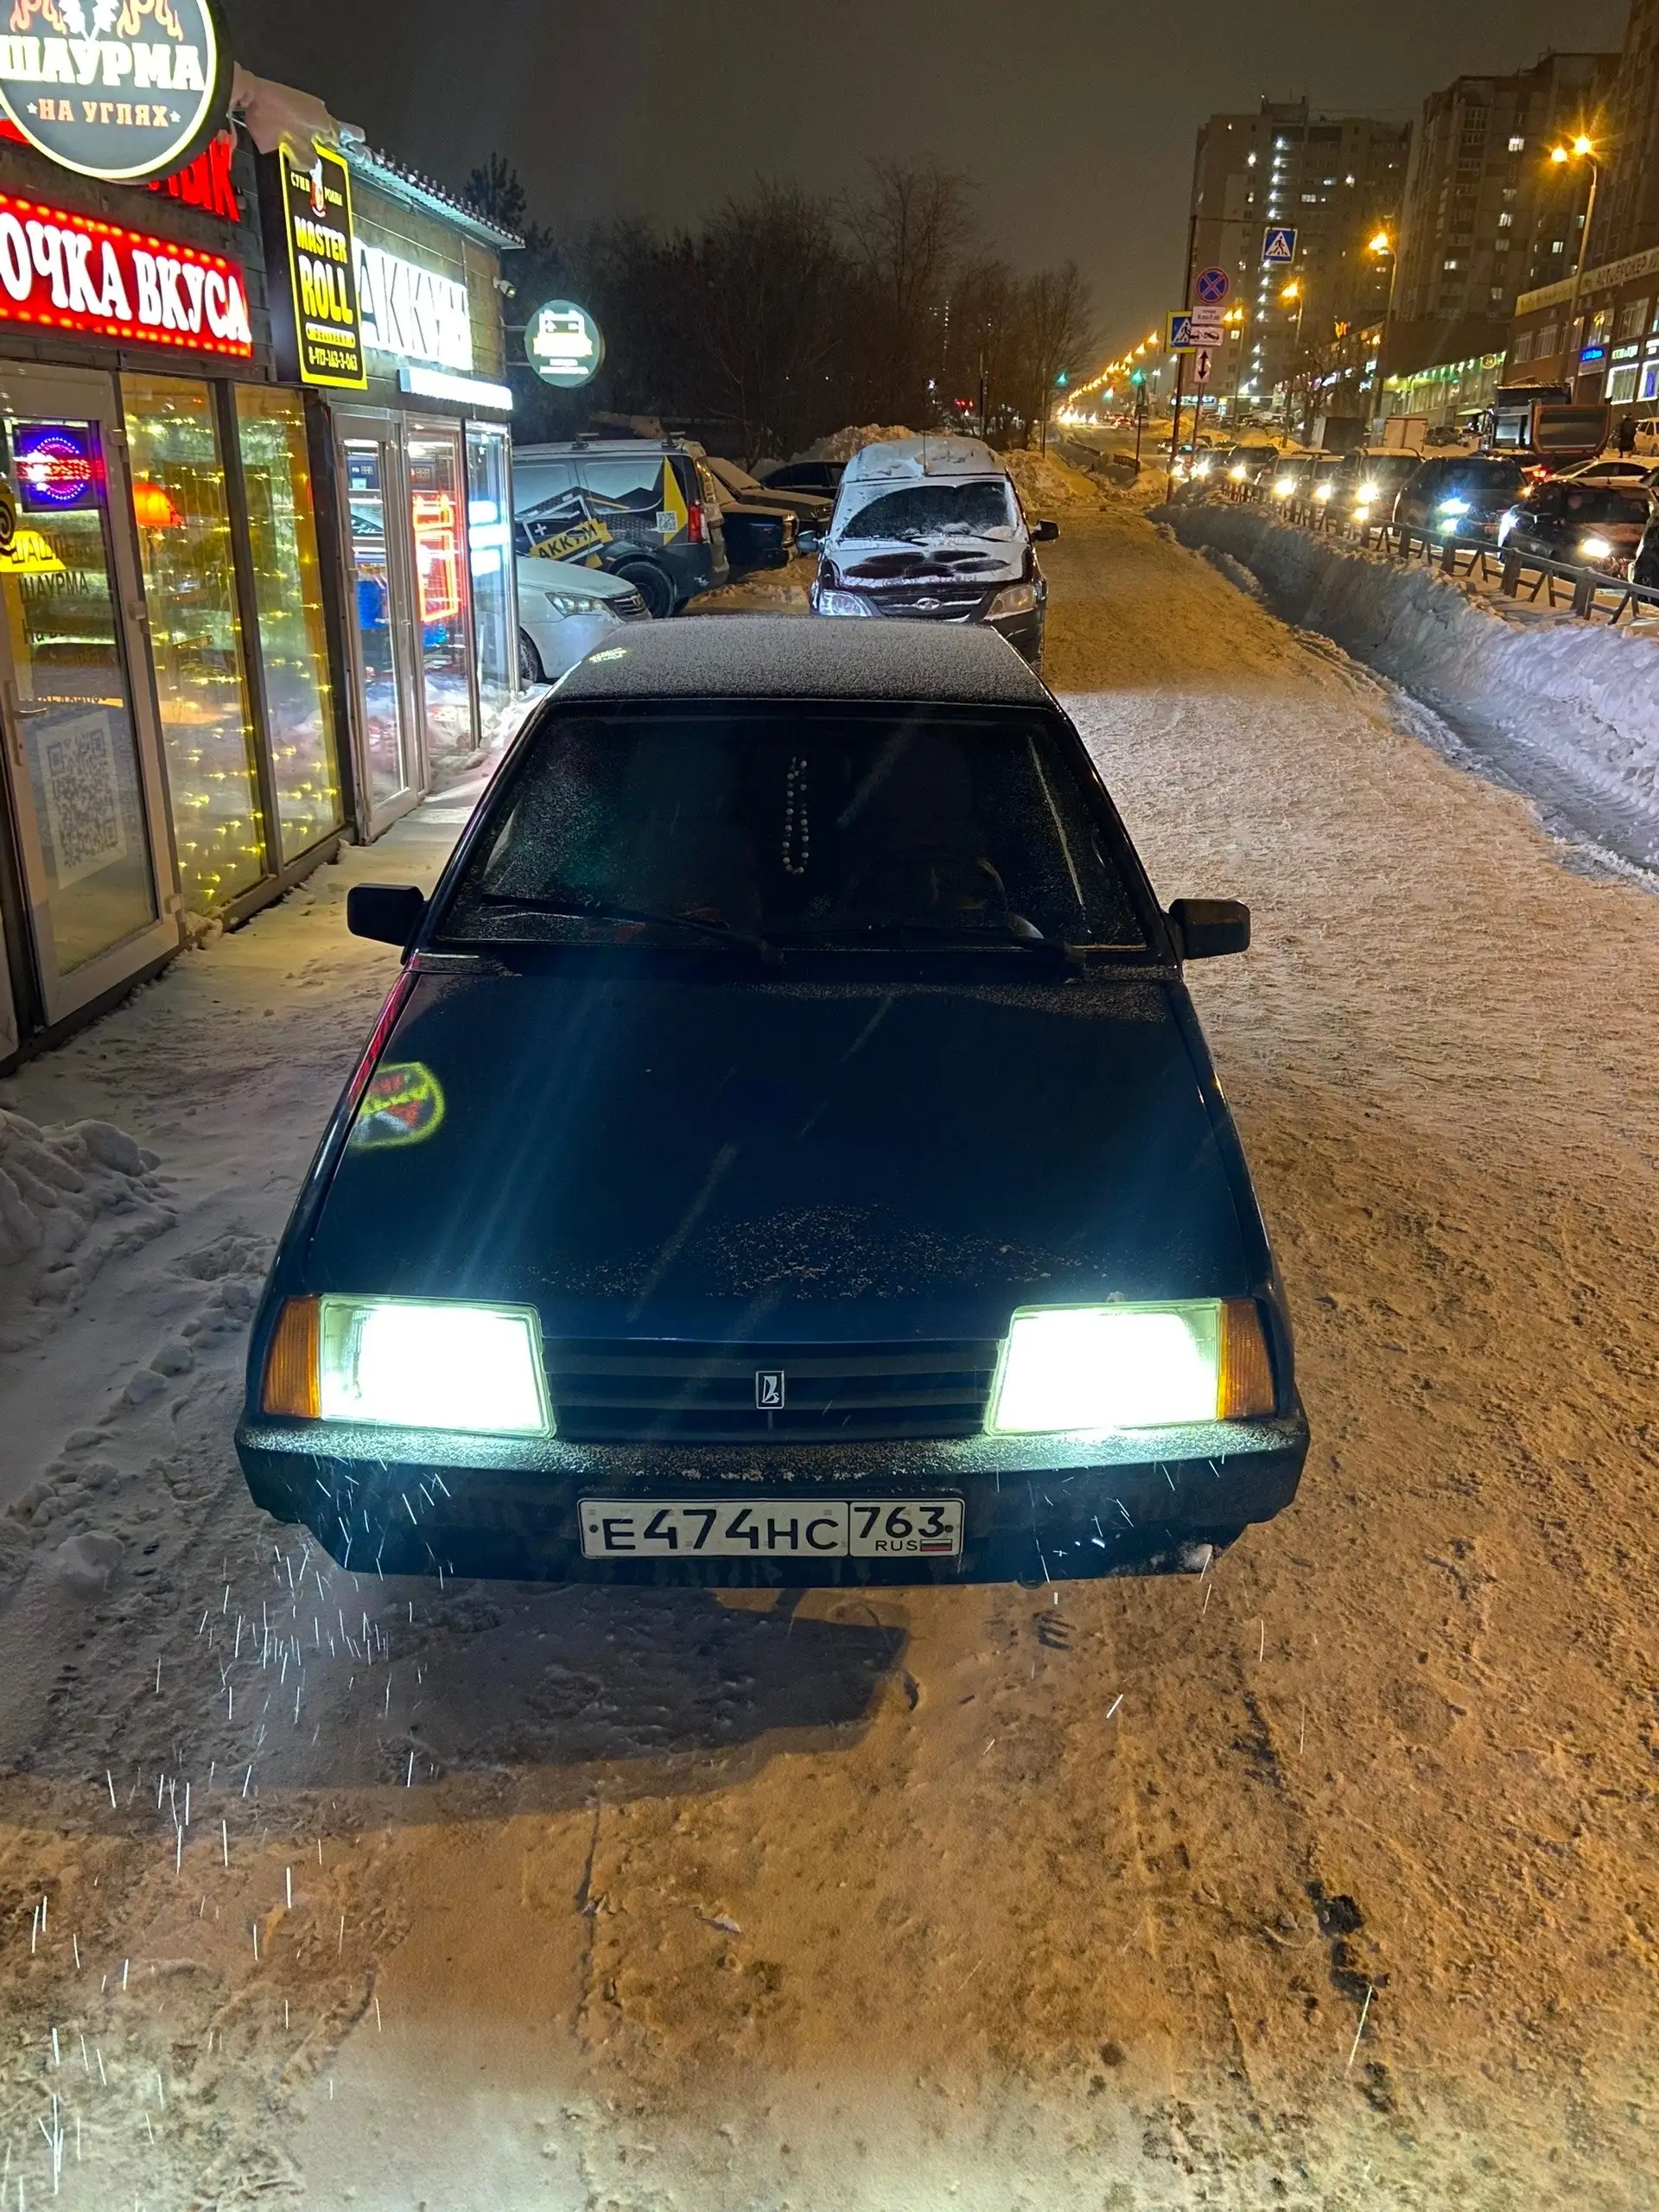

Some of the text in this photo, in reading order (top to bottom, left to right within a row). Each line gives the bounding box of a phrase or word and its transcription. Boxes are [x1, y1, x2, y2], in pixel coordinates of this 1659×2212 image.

[0, 35, 205, 91] ШАУРМА
[38, 98, 168, 127] НА УГЛЯХ
[294, 215, 347, 264] MASTER
[132, 249, 252, 344] ВКУСА
[298, 254, 353, 325] ROLL
[19, 570, 90, 603] ШАУРМА
[854, 1506, 944, 1538] 763
[875, 1540, 918, 1552] RUS
